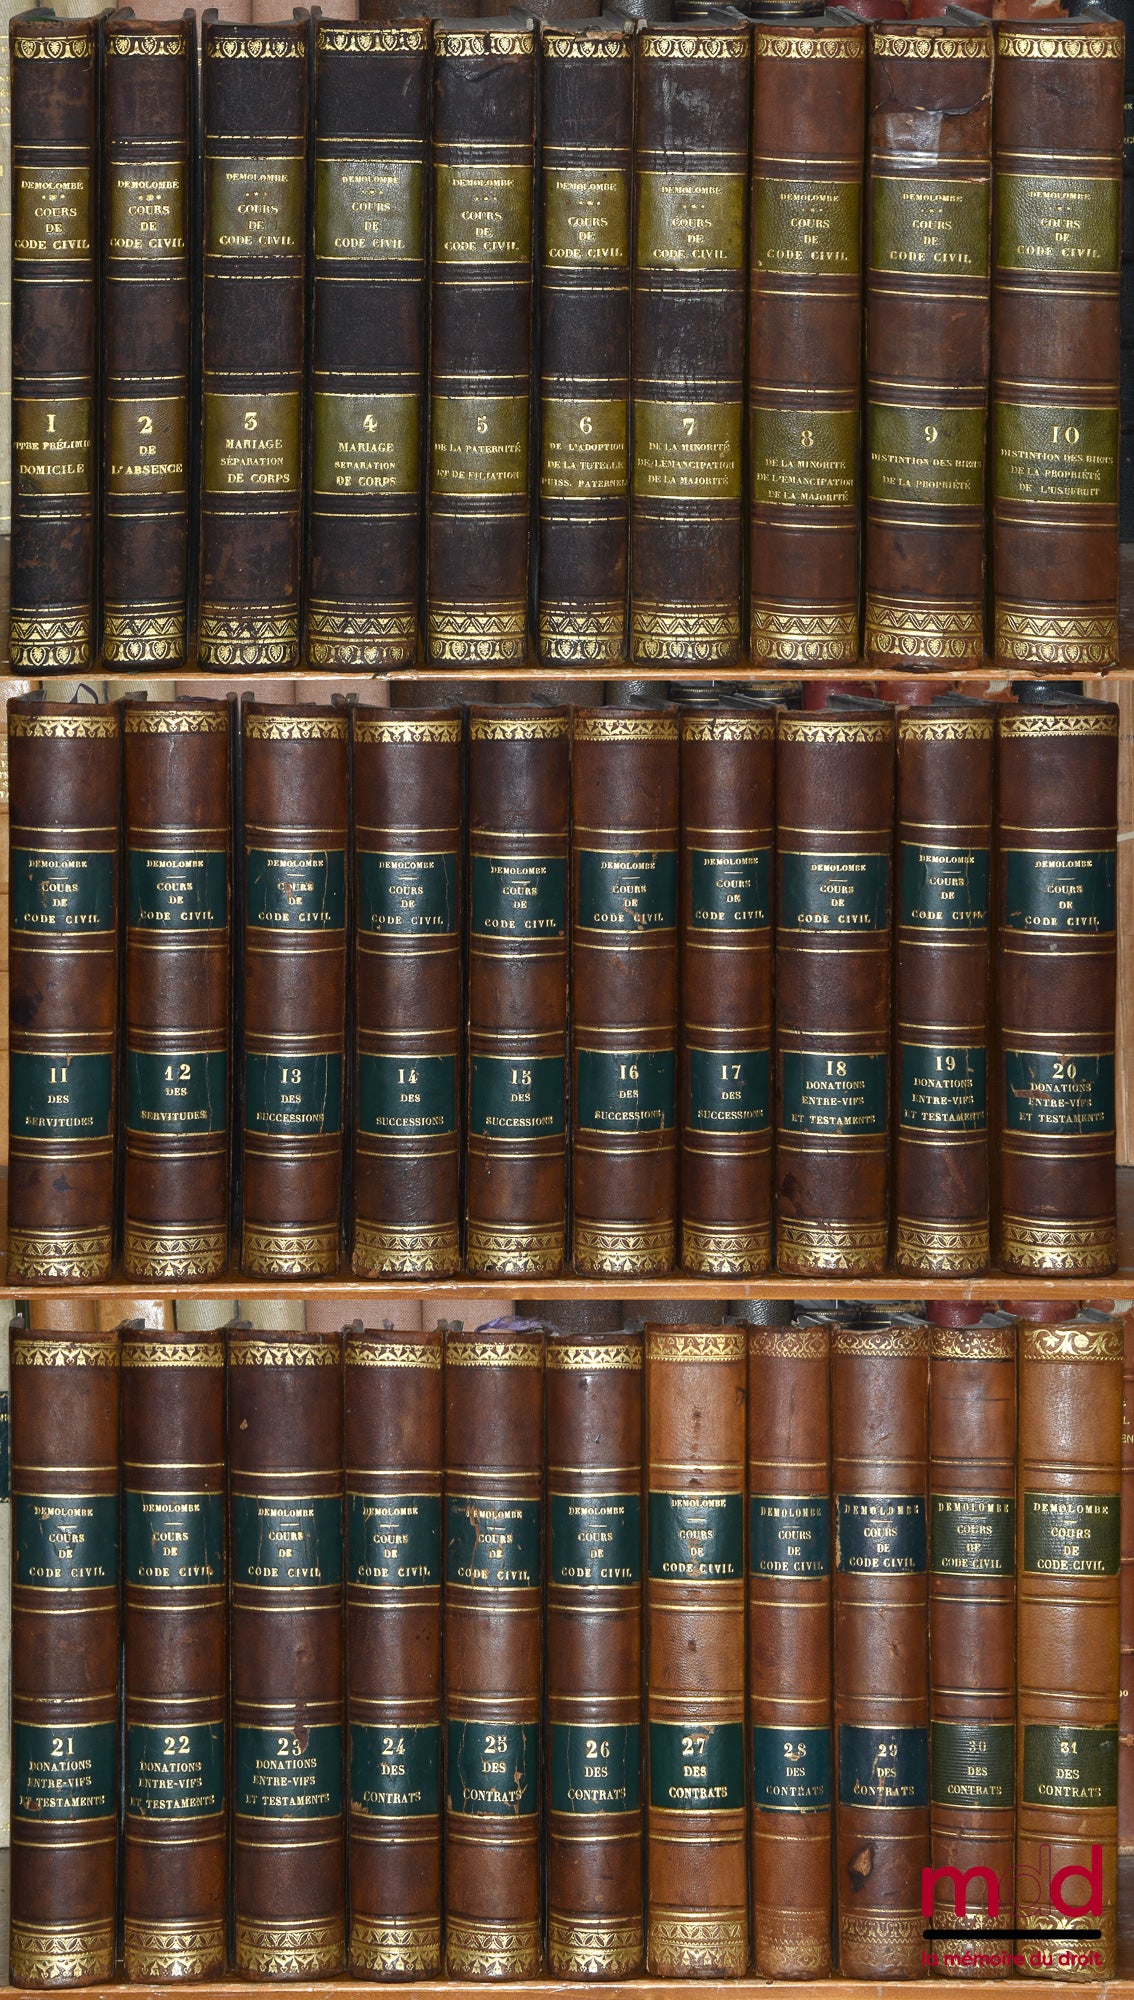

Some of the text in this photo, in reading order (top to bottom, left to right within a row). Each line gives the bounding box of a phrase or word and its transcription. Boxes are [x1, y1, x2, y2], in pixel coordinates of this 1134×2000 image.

[226, 173, 288, 182] DEMOLOMBE
[34, 207, 77, 217] COURS
[128, 205, 170, 215] COURS
[237, 204, 278, 214] COURS
[351, 201, 391, 212] COURS
[248, 220, 265, 230] DE
[567, 217, 608, 227] COURS
[672, 218, 712, 227] COURS
[790, 218, 830, 228] COURS
[912, 220, 952, 229] COURS
[1041, 218, 1080, 228] COURS
[14, 239, 90, 250] CODE CIVIL
[110, 238, 185, 248] CODE CIVIL
[219, 235, 294, 245] CODE CIVIL
[334, 238, 406, 249] CODE CIVIL
[804, 235, 819, 244] DE
[923, 236, 939, 245] DE
[444, 241, 519, 251] CODE CIVIL
[1017, 245, 1100, 258] CODE CIVIL
[549, 248, 623, 258] CODE CIVIL
[653, 249, 727, 258] CODE CIVIL
[767, 249, 847, 261] CODE CIVIL
[890, 251, 972, 263] CODE CIVIL
[137, 416, 152, 434] 2
[244, 412, 258, 431] 3
[363, 414, 377, 432] 4
[476, 416, 488, 434] 5
[580, 416, 593, 433] 6
[682, 418, 695, 436] 7
[800, 430, 814, 447] 8
[924, 425, 937, 443] 9
[1050, 426, 1080, 443] 10
[225, 439, 283, 449] MARIAGE
[338, 442, 394, 452] MARIAGE
[434, 443, 447, 451] DE
[450, 443, 462, 452] LA
[139, 445, 156, 455] DE
[20, 464, 85, 475] DOMICILE
[1011, 465, 1024, 474] DE
[1027, 467, 1039, 475] LA
[227, 473, 290, 483] DE CORPS
[336, 476, 396, 487] DE CORPS
[648, 475, 662, 483] DE
[29, 859, 87, 868] DEMOLOMBE
[41, 883, 79, 892] COURS
[157, 882, 193, 892] COURS
[716, 879, 750, 888] COURS
[1047, 885, 1083, 893] COURS
[388, 886, 424, 895] COURS
[820, 885, 854, 894] COURS
[826, 1061, 847, 1076] 18
[935, 1056, 956, 1071] 19
[164, 1063, 191, 1081] 12
[619, 1064, 639, 1080] 16
[721, 1064, 742, 1079] 17
[1052, 1062, 1077, 1078] 20
[281, 1068, 302, 1084] 13
[398, 1069, 418, 1084] 14
[511, 1070, 532, 1085] 15
[806, 1080, 865, 1090] DONATIONS
[914, 1077, 973, 1088] DONATIONS
[1031, 1083, 1091, 1092] DONATIONS
[165, 1087, 187, 1096] DES
[619, 1089, 639, 1099] DES
[721, 1091, 741, 1100] DES
[47, 1094, 69, 1104] DES
[281, 1094, 302, 1104] DES
[400, 1093, 420, 1103] DES
[511, 1093, 531, 1102] DES
[801, 1095, 864, 1105] ENTRE-VIFS
[912, 1094, 974, 1105] ENTRE-VIFS
[1028, 1098, 1092, 1107] ENTRE-VIFS
[257, 1111, 325, 1122] SUCCESSIONS
[595, 1109, 662, 1120] SUCCESSIONS
[697, 1109, 763, 1120] SUCCESSIONS
[376, 1116, 444, 1126] SUCCESSIONS
[485, 1116, 553, 1127] SUCCESSIONS
[671, 1499, 726, 1507] DEMOLOMBE
[938, 1502, 1009, 1513] DEMOLOMBE
[1033, 1503, 1109, 1514] DEMOLOMBE
[679, 1530, 713, 1539] COURS
[778, 1530, 812, 1540] COURS
[864, 1528, 898, 1537] COURS
[957, 1525, 993, 1534] COURS
[1050, 1527, 1091, 1538] COURS
[49, 1533, 85, 1543] COURS
[1037, 1559, 1105, 1571] CODE CIVIL
[51, 1737, 74, 1756] 21
[163, 1736, 191, 1755] 22
[381, 1737, 406, 1755] 24
[484, 1735, 508, 1754] 25
[585, 1741, 610, 1758] 26
[682, 1738, 706, 1756] 27
[969, 1740, 986, 1752] 30
[1060, 1742, 1077, 1754] 31
[784, 1743, 807, 1758] 28
[878, 1744, 898, 1757] 29
[29, 1760, 92, 1771] DONATIONS
[139, 1761, 202, 1771] DONATIONS
[255, 1758, 317, 1769] DONATIONS
[482, 1762, 506, 1774] DES
[381, 1764, 405, 1776] DES
[584, 1766, 608, 1777] DES
[684, 1766, 706, 1777] DES
[786, 1767, 806, 1776] DES
[877, 1768, 896, 1777] DES
[968, 1767, 988, 1776] DES
[1056, 1769, 1080, 1779] DES
[27, 1777, 92, 1787] ENTRE-VIFS
[138, 1778, 203, 1788] ENTRE-VIFS
[253, 1775, 316, 1786] ENTRE-VIFS
[463, 1789, 522, 1802] CONTRATS
[567, 1788, 626, 1801] CONTRATS
[669, 1787, 728, 1799] CONTRATS
[766, 1785, 824, 1796] CONTRATS
[854, 1785, 914, 1796] CONTRATS
[947, 1785, 1002, 1795] CONTRATS
[1038, 1785, 1101, 1797] CONTRATS
[363, 1791, 421, 1804] CONTRATS
